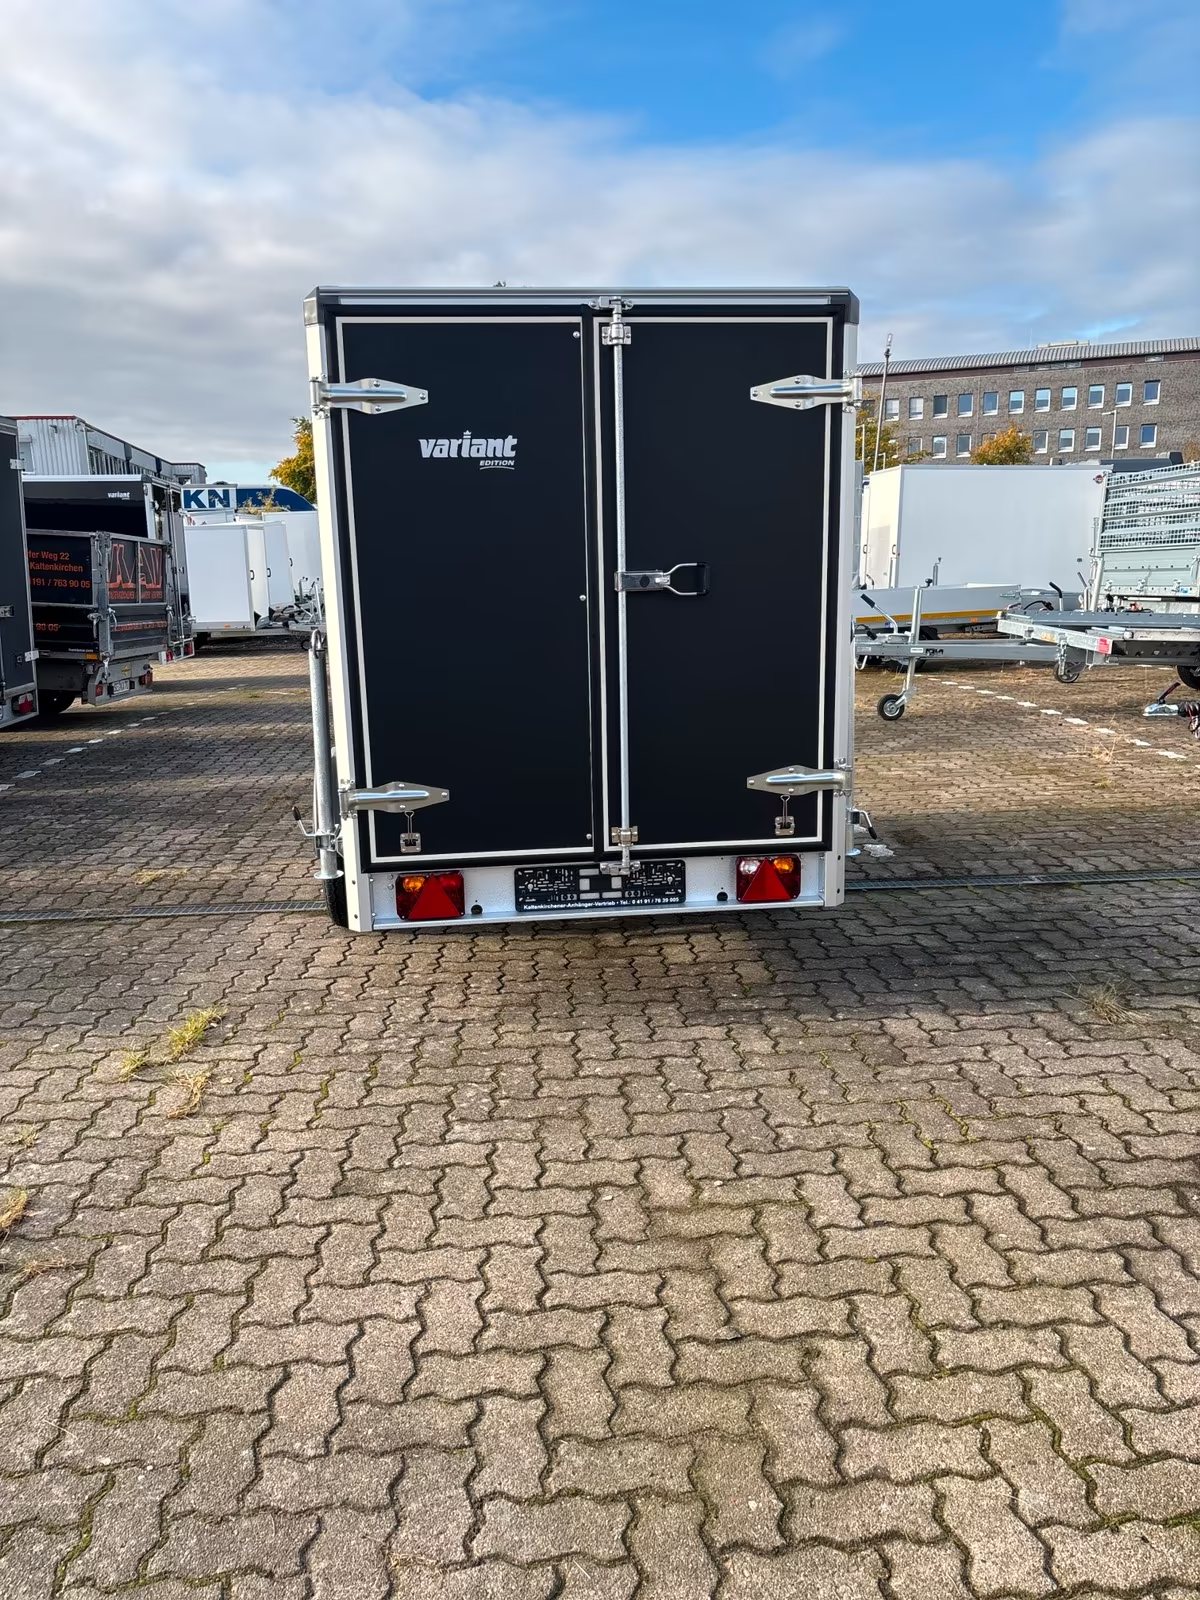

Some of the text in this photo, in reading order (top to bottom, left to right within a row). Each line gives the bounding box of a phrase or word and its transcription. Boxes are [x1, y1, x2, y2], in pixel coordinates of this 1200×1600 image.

[418, 430, 518, 458] variant
[107, 491, 131, 499] variant
[183, 489, 231, 509] KN
[27, 550, 70, 561] fer Weg 22
[29, 562, 83, 572] Kaltenkirchen
[30, 578, 45, 586] 191
[53, 579, 68, 587] 763
[69, 579, 79, 588] 90
[80, 580, 91, 588] 05
[523, 900, 615, 910] Kaltenkirchener-Anhänger-Vertrieb
